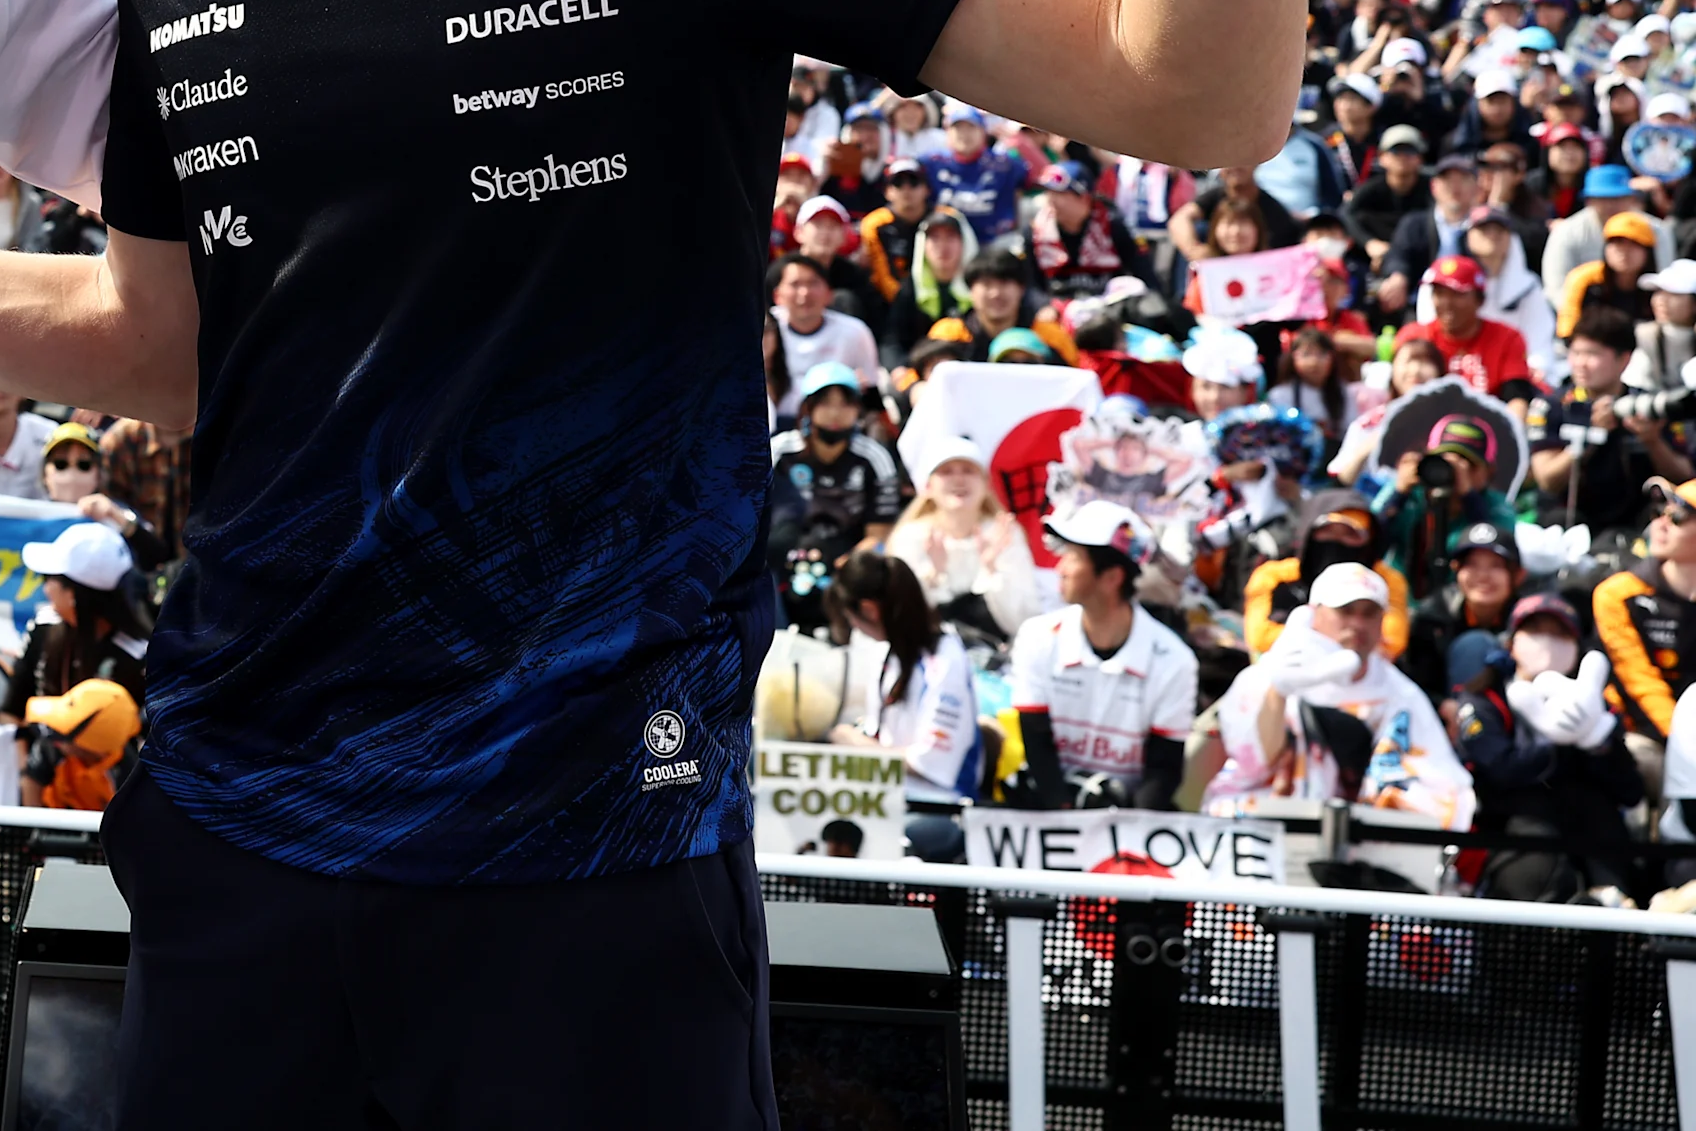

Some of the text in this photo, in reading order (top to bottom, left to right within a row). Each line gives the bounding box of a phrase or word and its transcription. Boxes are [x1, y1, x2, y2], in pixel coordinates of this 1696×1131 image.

[149, 2, 245, 54] KOMATSU
[170, 68, 249, 112] Claude
[453, 70, 625, 115] betway SCORES
[470, 152, 628, 203] Stephens
[644, 760, 698, 783] COOLERA
[760, 751, 903, 785] LET HIM
[772, 788, 887, 817] COOK
[986, 823, 1273, 879] WE LOVE
